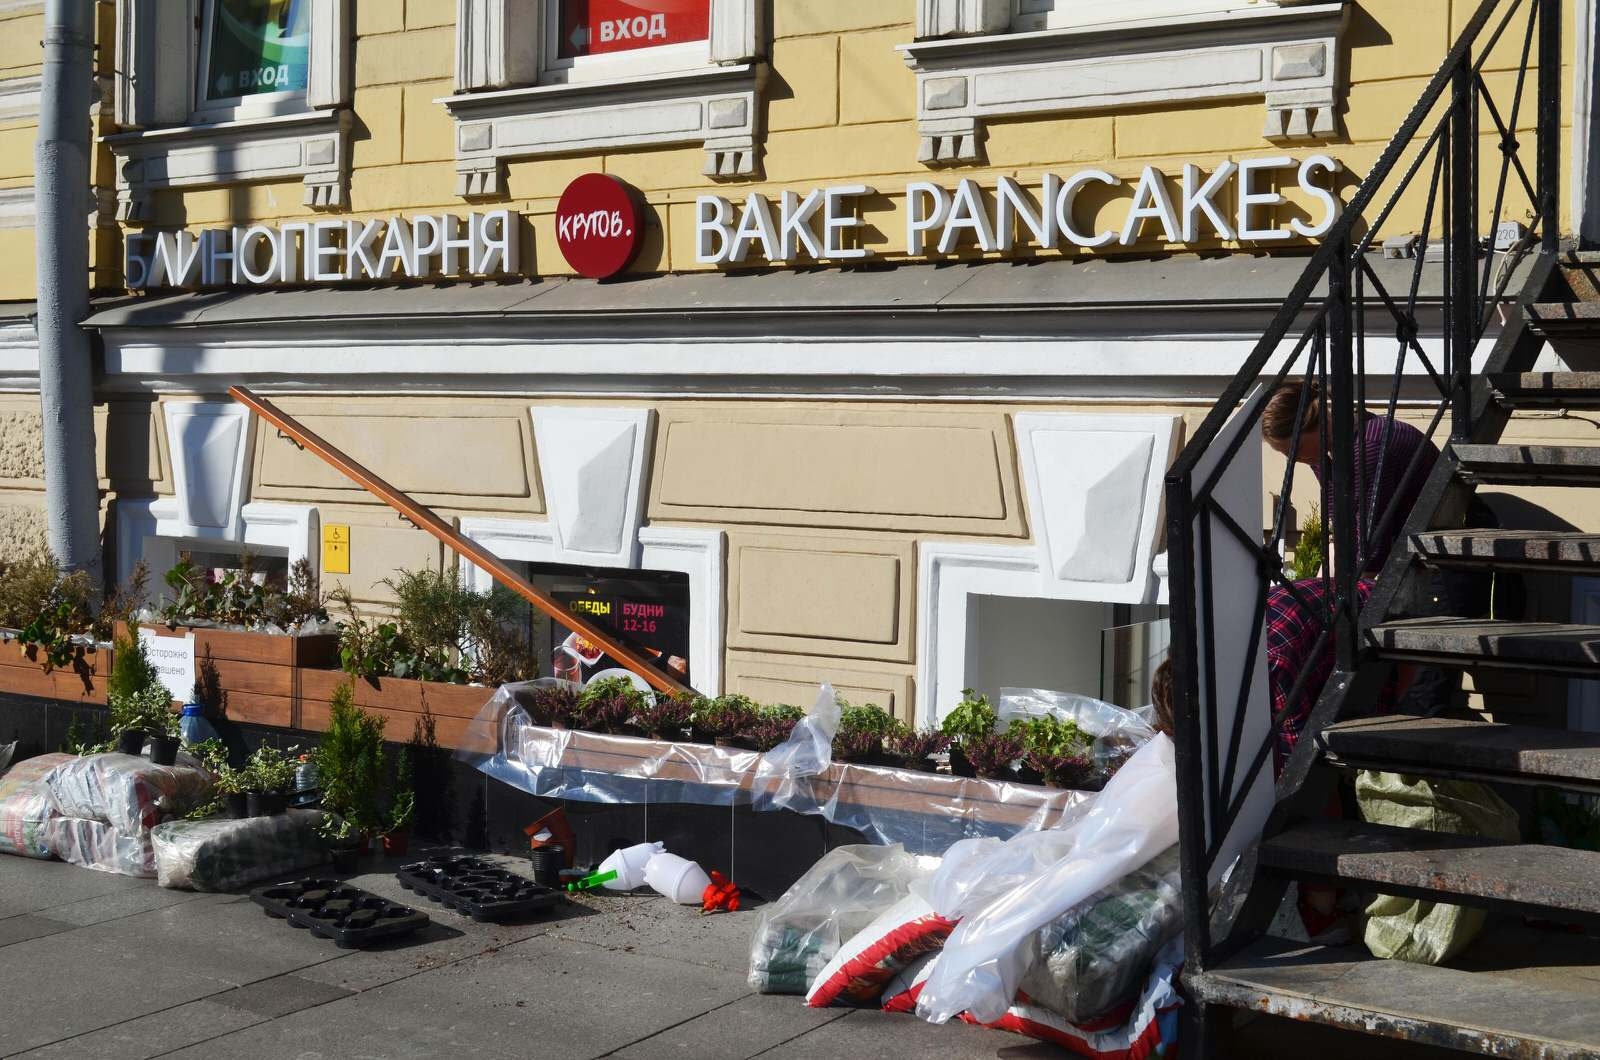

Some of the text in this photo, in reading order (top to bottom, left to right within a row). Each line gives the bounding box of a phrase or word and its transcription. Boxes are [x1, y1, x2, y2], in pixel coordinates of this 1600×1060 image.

[600, 13, 667, 42] ВХОД
[239, 64, 289, 88] ВХОД
[696, 154, 1342, 264] BAKE PANCAKES
[127, 210, 518, 289] БЛИНОПЕКАРНЯ
[570, 601, 664, 618] ОБЕДЫ БУДНИ
[623, 620, 657, 633] 12-16
[145, 646, 188, 660] Осторожно
